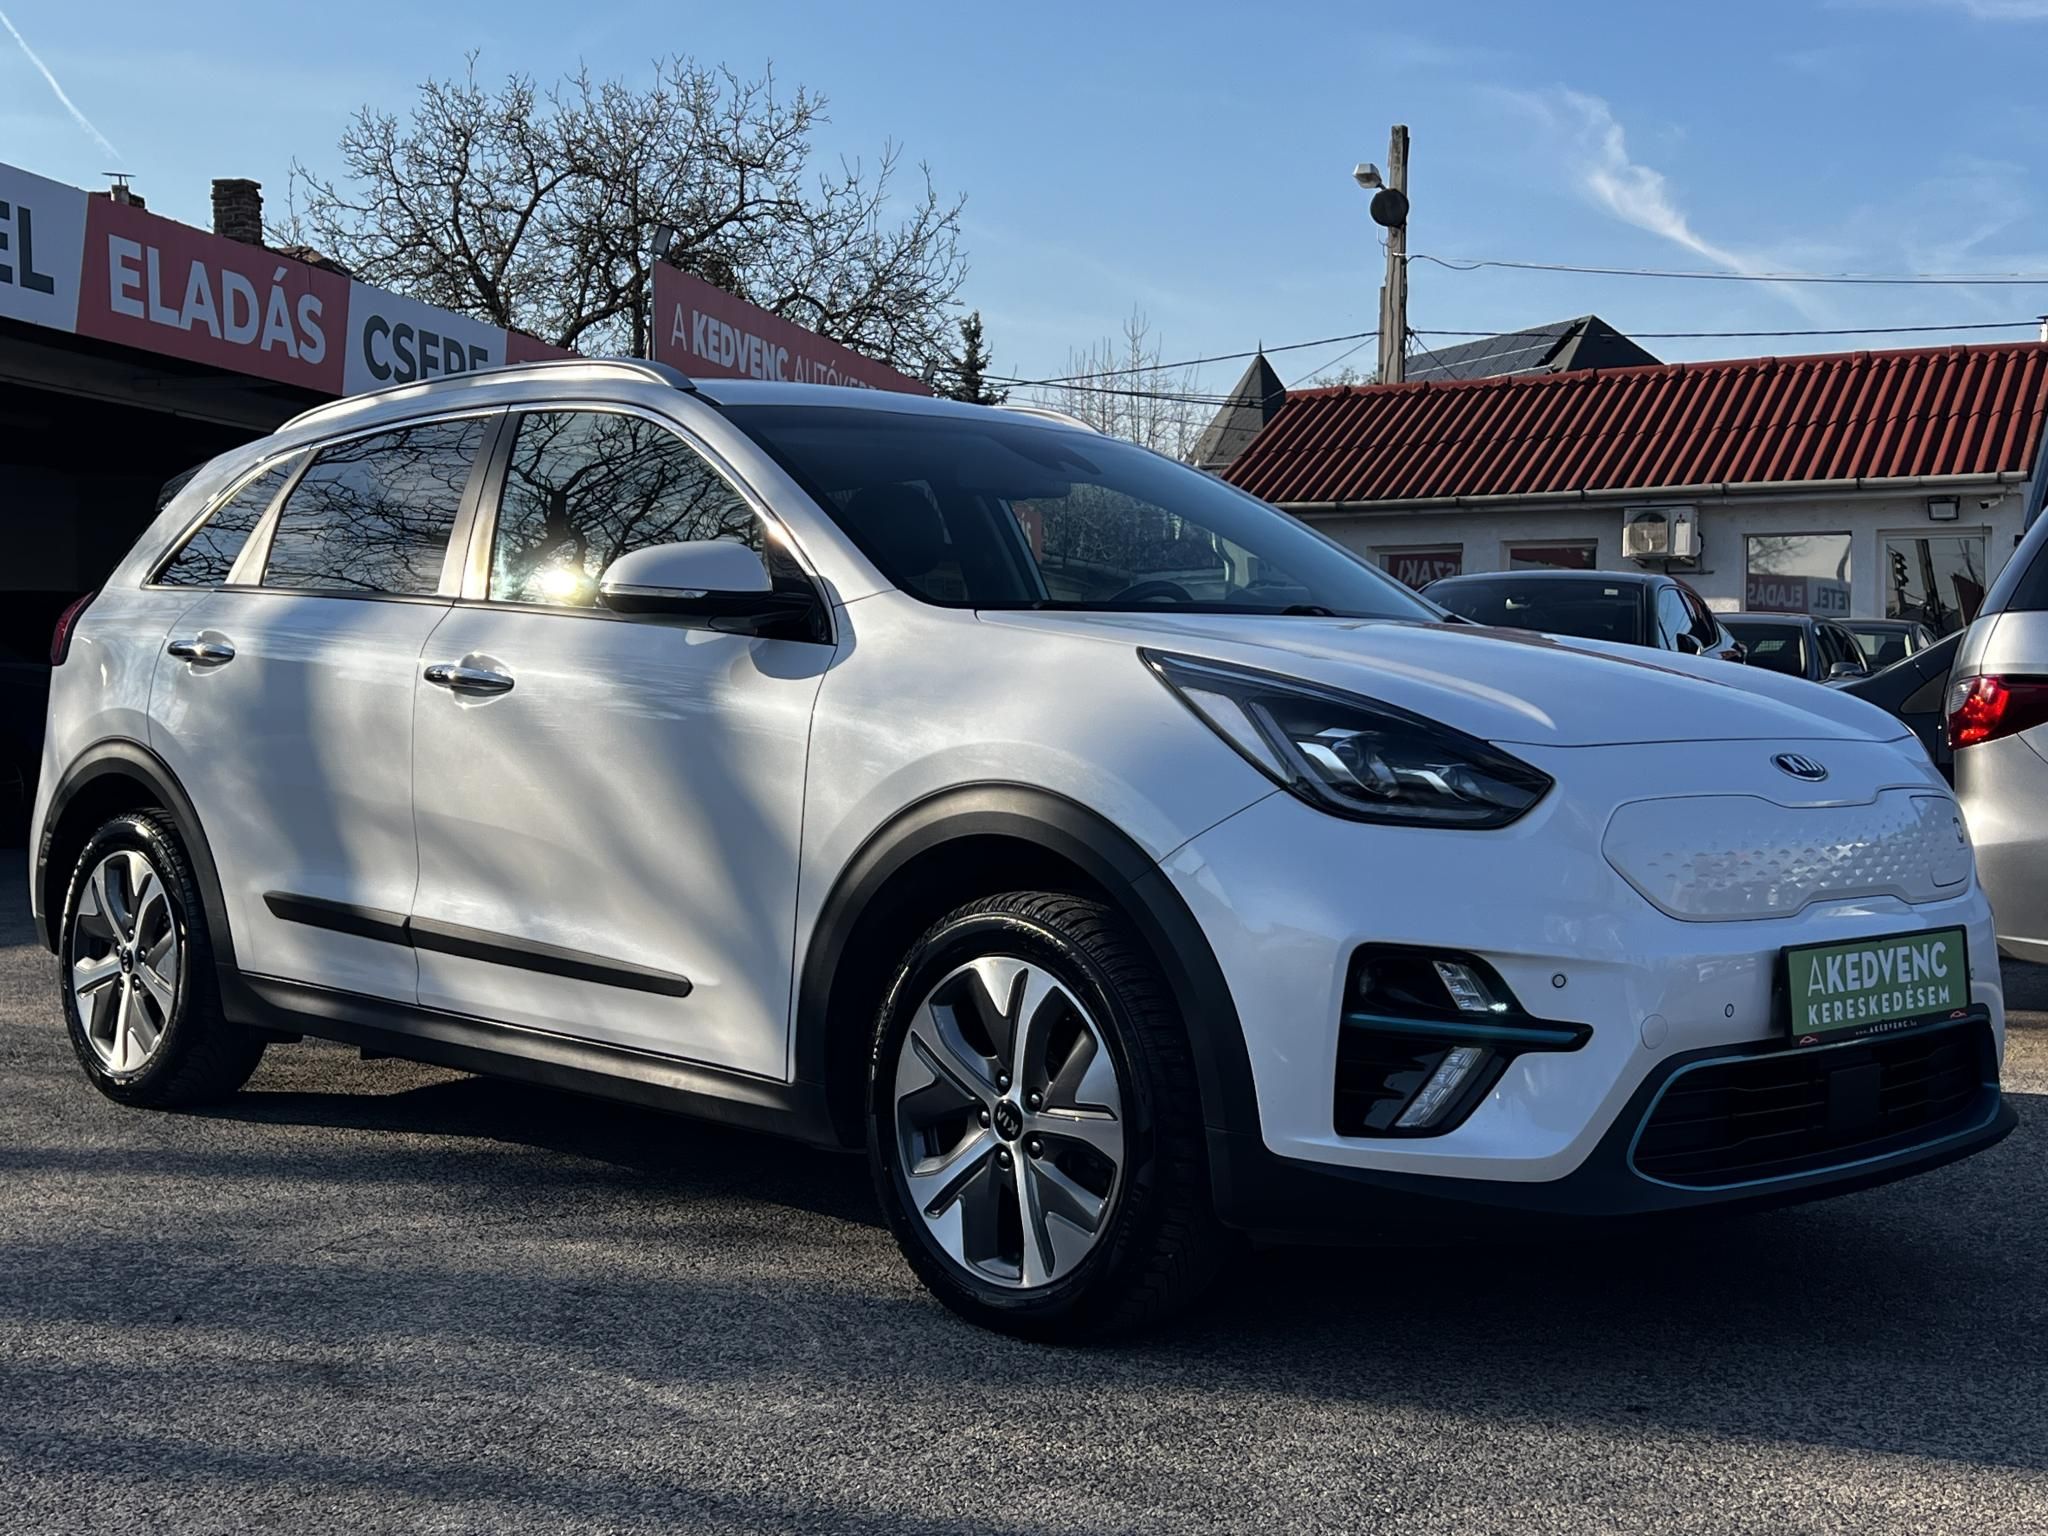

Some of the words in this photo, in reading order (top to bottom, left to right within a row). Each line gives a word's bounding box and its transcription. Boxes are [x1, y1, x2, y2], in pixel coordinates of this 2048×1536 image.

[108, 233, 327, 365] ELADÁS
[671, 303, 688, 351] A
[692, 310, 789, 382] KEDVENC
[1807, 984, 1950, 1026] KERESKEDÉSEM
